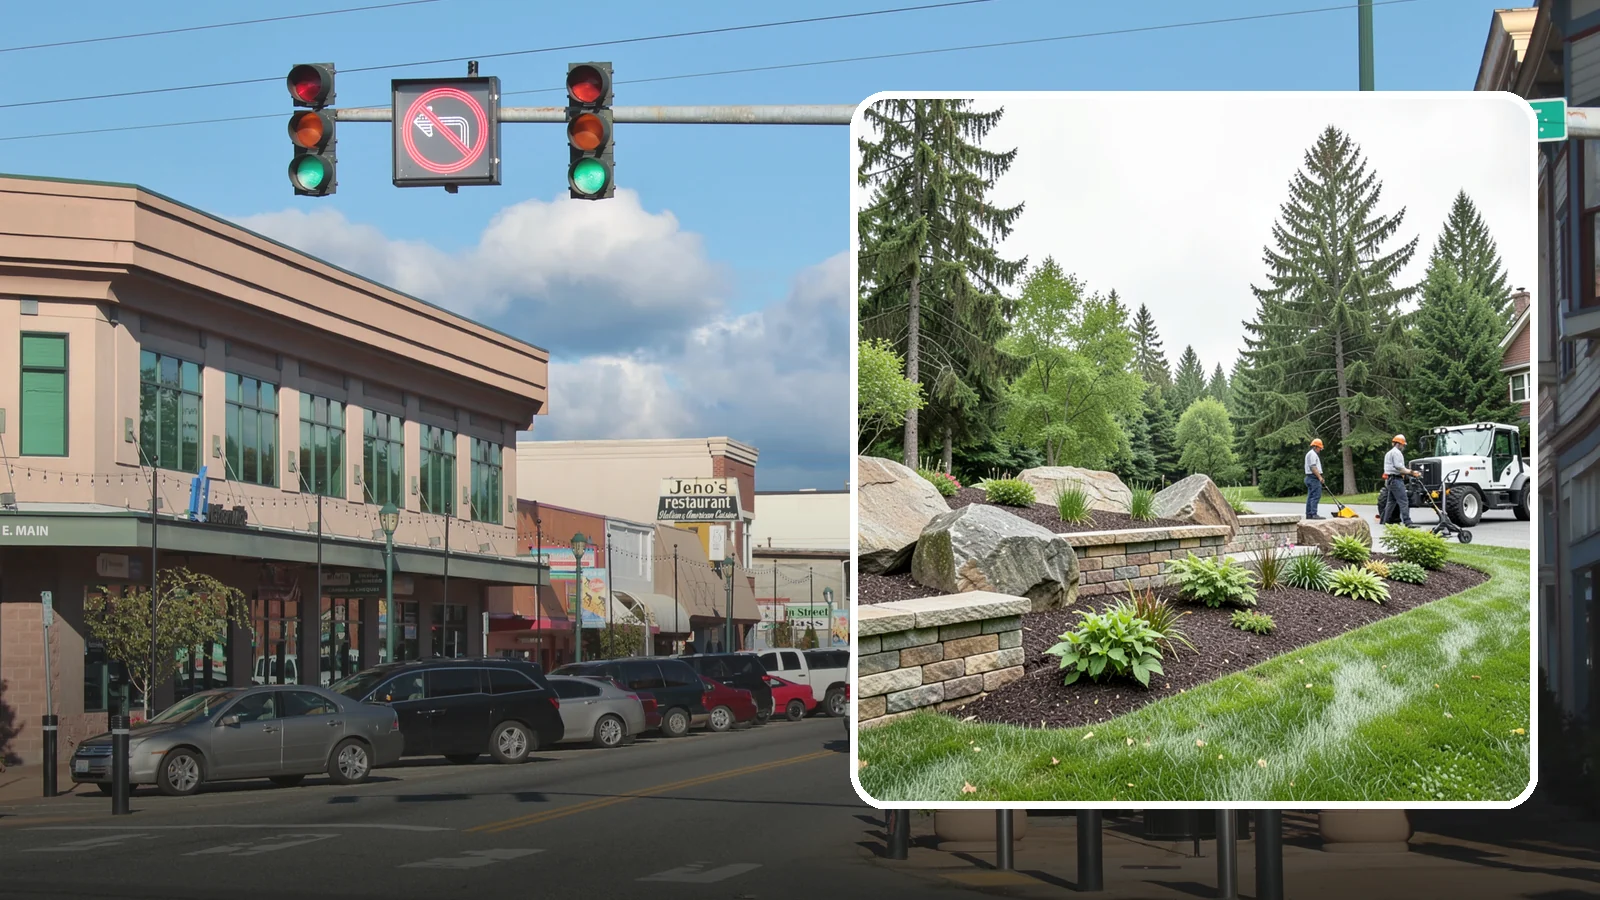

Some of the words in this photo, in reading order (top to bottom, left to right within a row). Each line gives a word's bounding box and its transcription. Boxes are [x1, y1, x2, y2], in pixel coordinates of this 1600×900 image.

[669, 480, 727, 494] Jeno's
[665, 496, 731, 509] restaurant
[658, 510, 682, 520] Italian
[686, 510, 714, 519] American
[714, 509, 737, 519] Cuisine
[2, 525, 13, 536] E.
[15, 525, 49, 537] MAIN
[797, 607, 829, 616] Street
